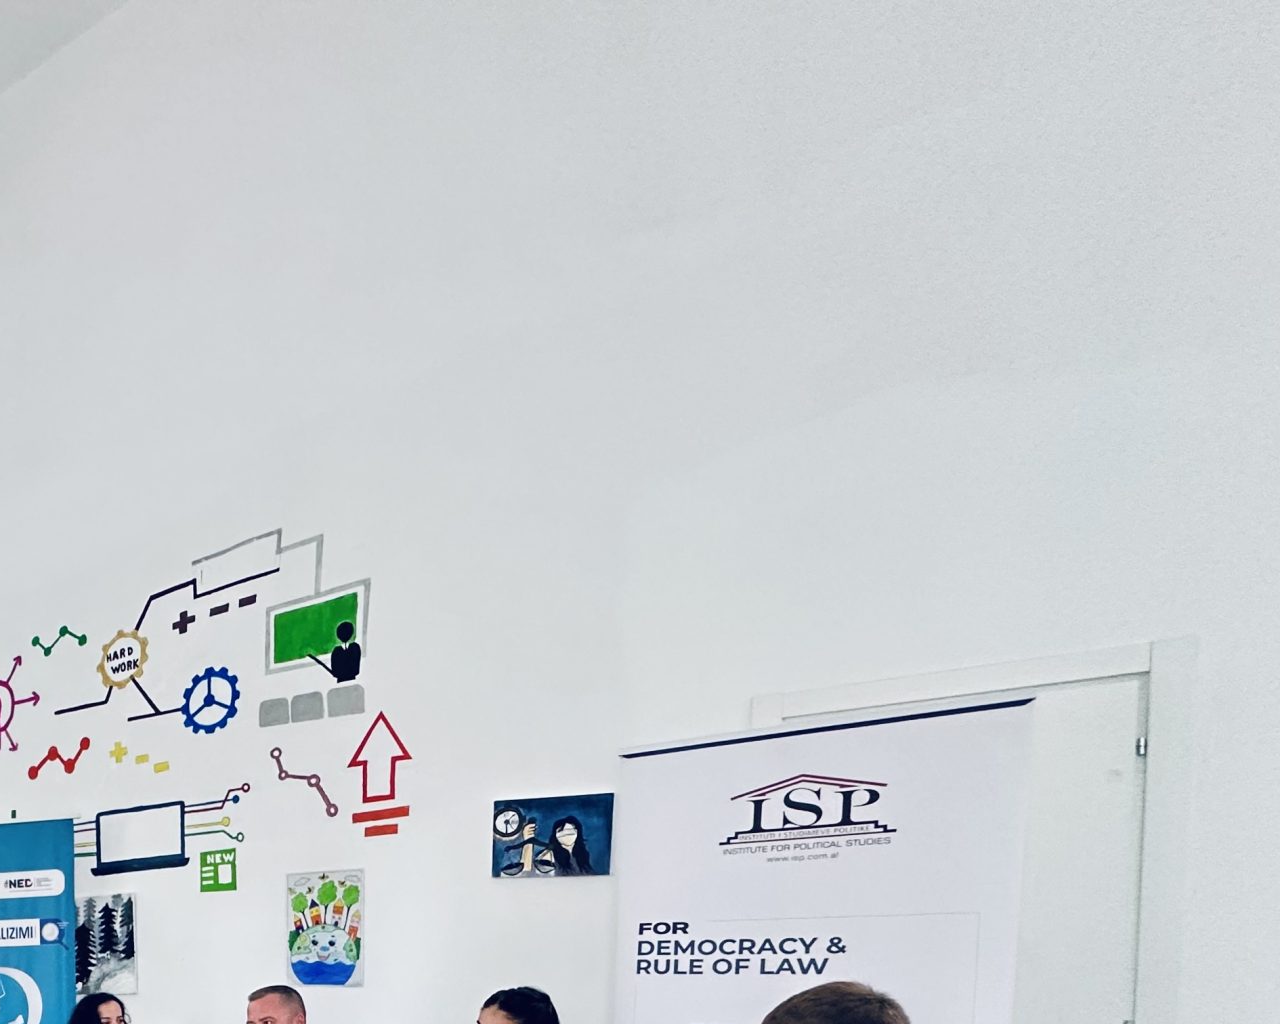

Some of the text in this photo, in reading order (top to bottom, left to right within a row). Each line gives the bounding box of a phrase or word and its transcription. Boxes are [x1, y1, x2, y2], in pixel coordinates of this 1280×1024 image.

[107, 646, 134, 663] HARD
[111, 658, 139, 674] WORK
[746, 787, 880, 831] ISP
[723, 836, 892, 855] INSTITUTE FOR POLITICAL STUDIES
[206, 851, 235, 864] NEW
[638, 921, 690, 935] FOR
[637, 936, 847, 956] DEMOCRACY &
[636, 957, 829, 975] RULE OF LAW
